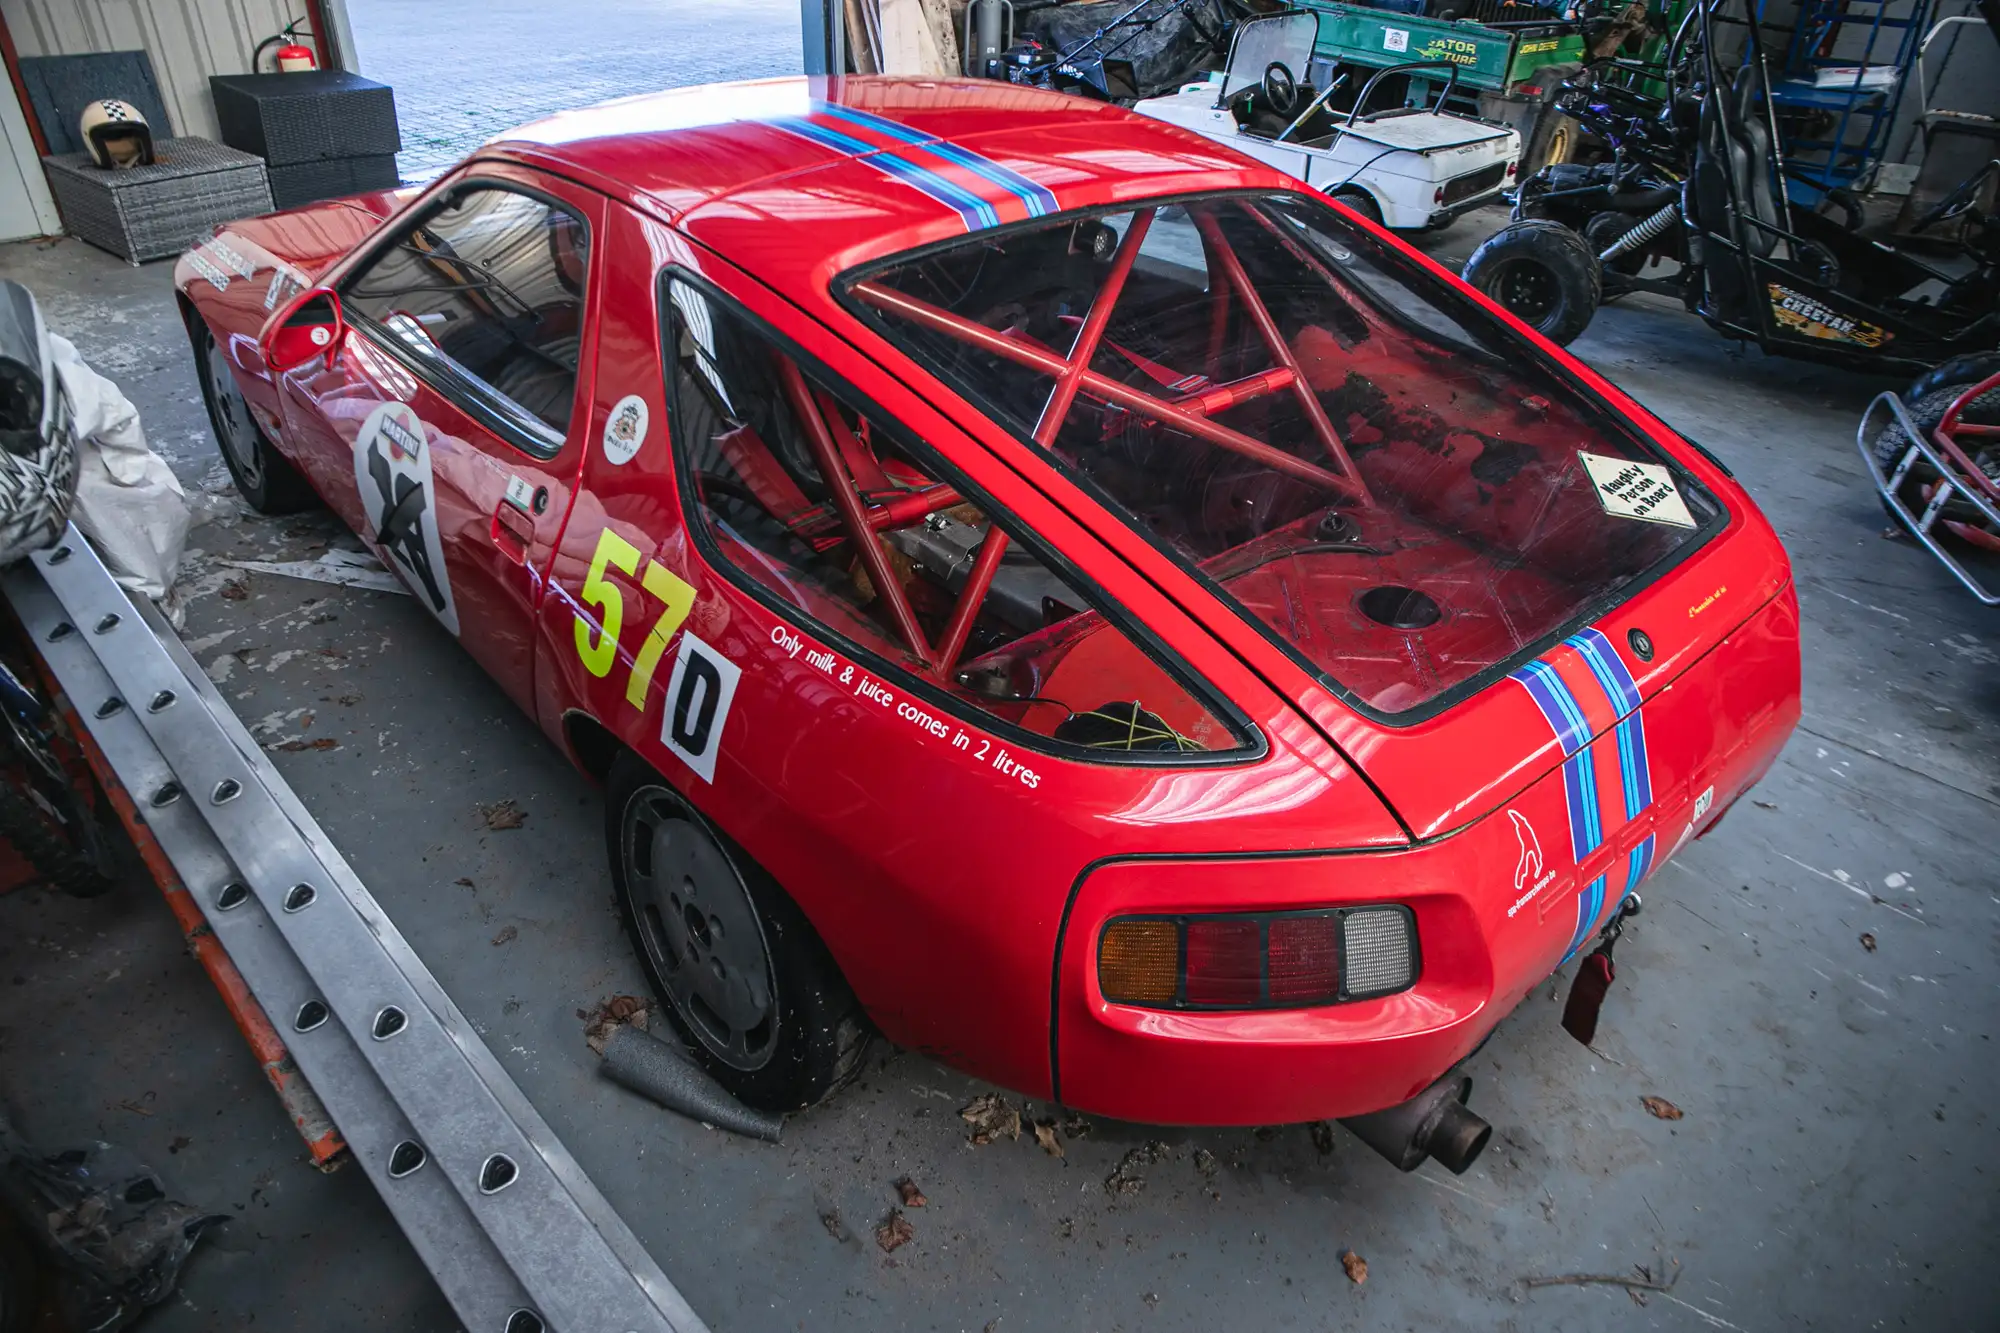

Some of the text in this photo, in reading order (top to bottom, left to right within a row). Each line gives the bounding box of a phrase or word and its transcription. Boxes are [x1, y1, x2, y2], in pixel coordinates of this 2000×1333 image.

[1444, 52, 1478, 65] TURF
[1519, 40, 1559, 54] JOHN DEERE
[1781, 297, 1857, 333] CHEETAH
[1599, 464, 1645, 495] Naughty
[1617, 478, 1656, 504] Person
[1633, 482, 1675, 516] on Board
[574, 526, 698, 713] 57
[671, 648, 721, 757] D
[770, 625, 1041, 789] Only milk & juice comes in 2 litres
